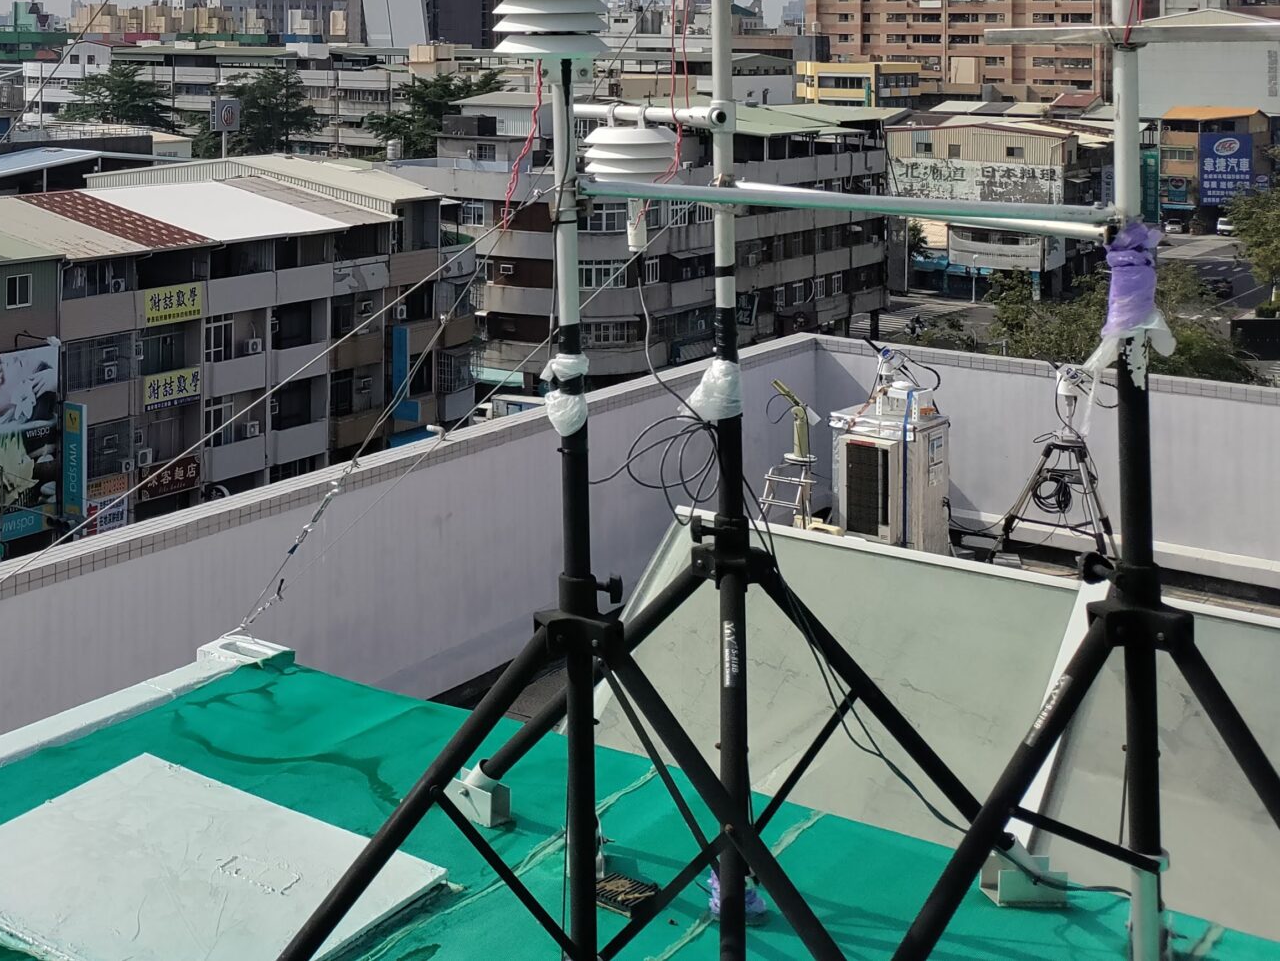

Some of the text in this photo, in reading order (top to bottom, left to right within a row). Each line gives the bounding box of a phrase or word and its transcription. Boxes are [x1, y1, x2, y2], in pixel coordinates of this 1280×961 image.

[899, 162, 1057, 182] 北海道 日本料理
